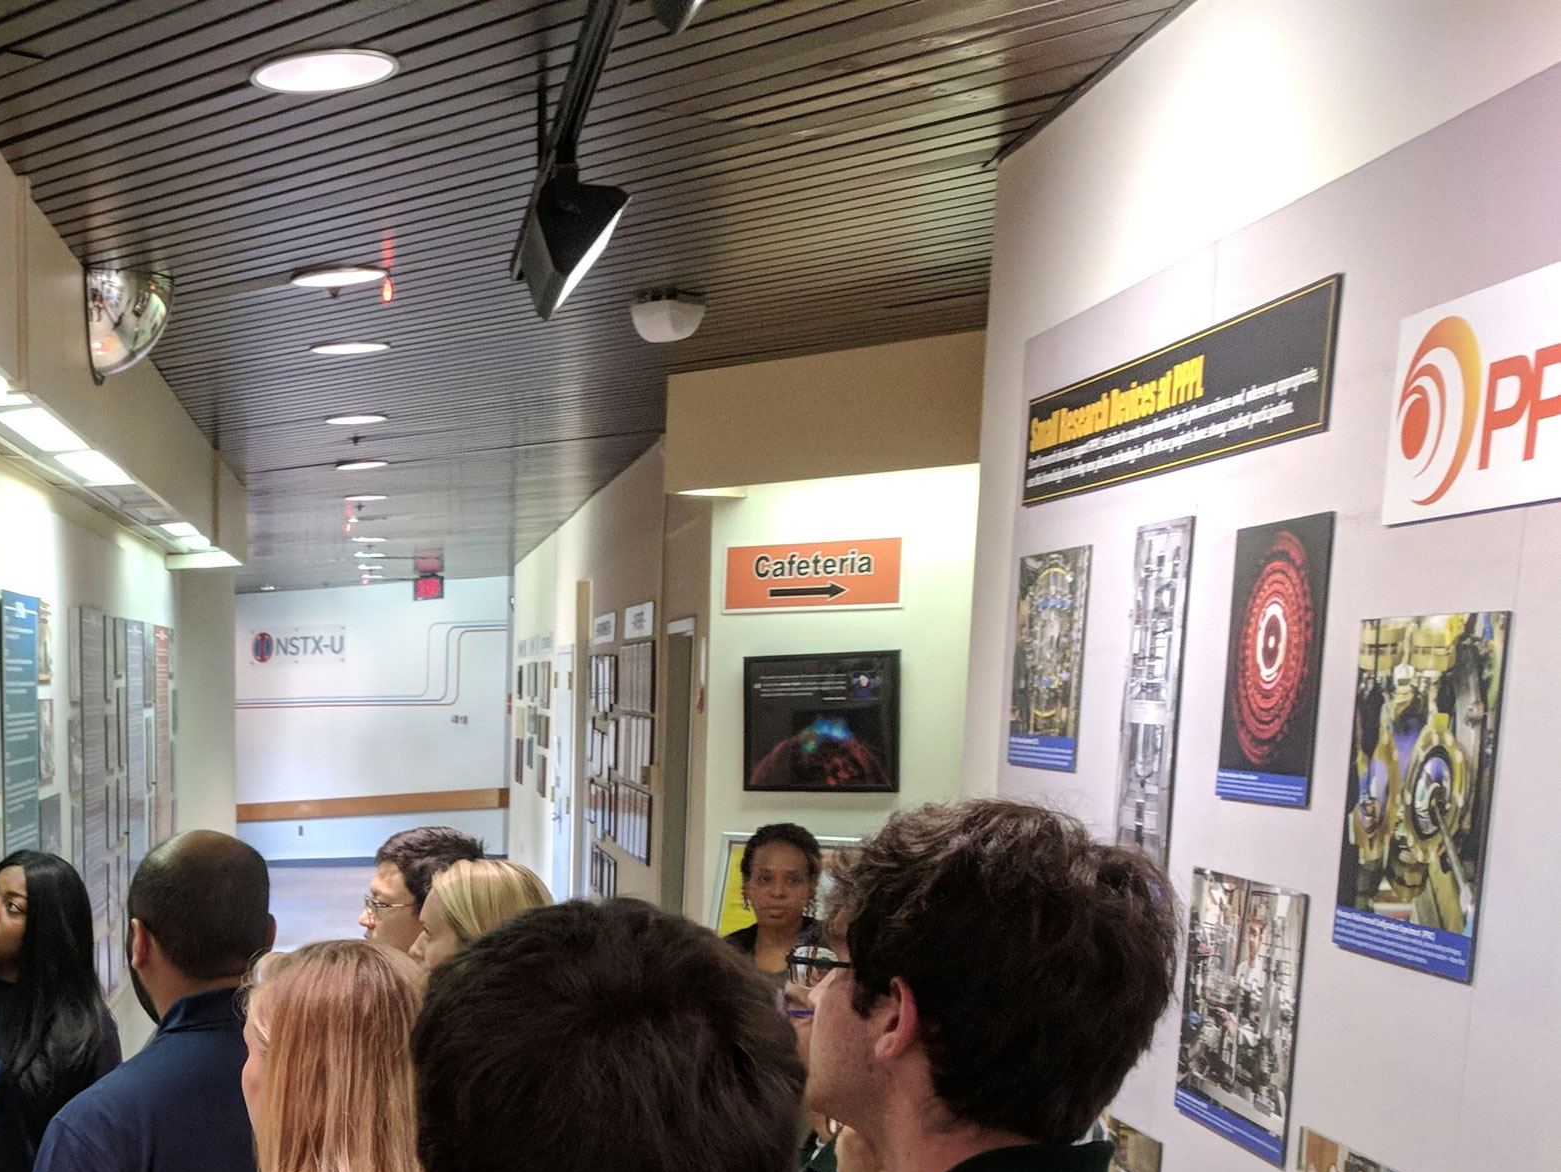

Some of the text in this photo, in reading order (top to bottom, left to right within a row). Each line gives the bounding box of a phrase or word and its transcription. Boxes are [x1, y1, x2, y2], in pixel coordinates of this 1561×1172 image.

[1173, 354, 1205, 405] PPPL
[754, 549, 874, 579] Cafeteria
[275, 635, 345, 657] NSTX-U
